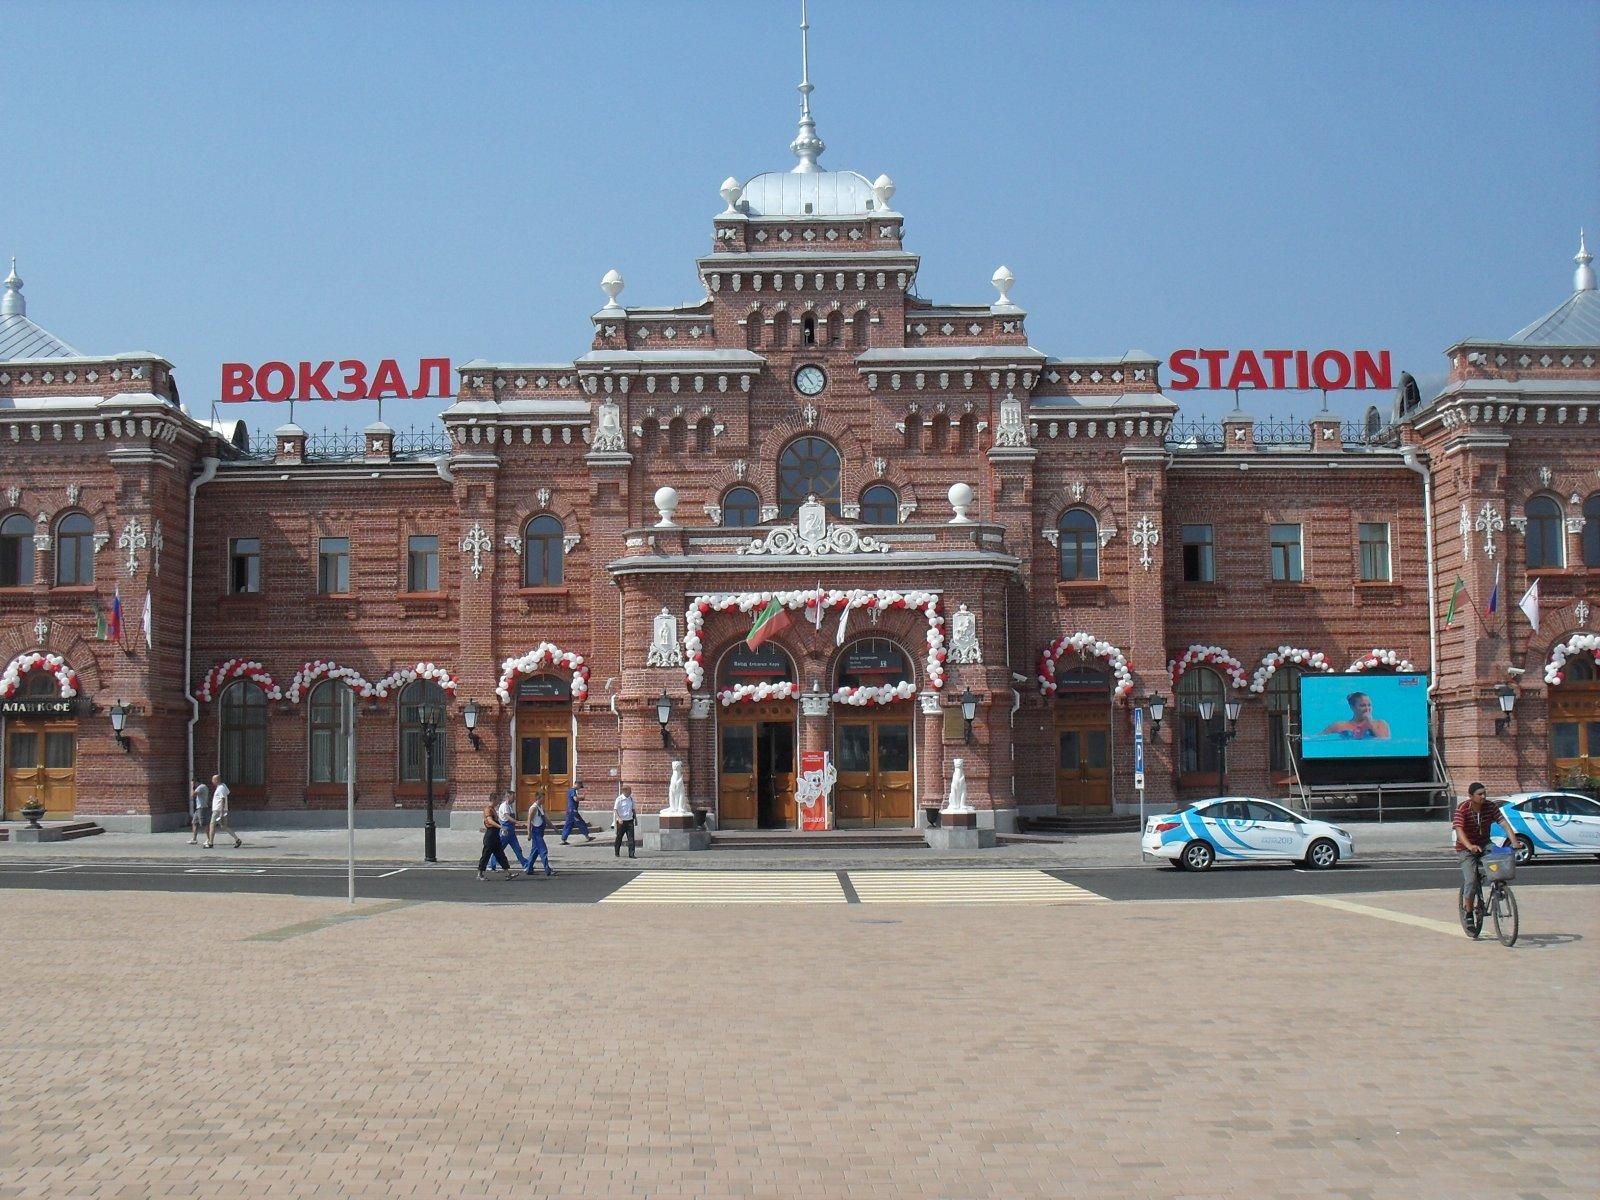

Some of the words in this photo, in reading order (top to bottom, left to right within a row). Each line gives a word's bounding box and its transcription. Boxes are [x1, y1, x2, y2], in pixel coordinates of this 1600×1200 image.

[221, 358, 450, 403] ВОКЗАЛ
[1169, 349, 1392, 391] STATION
[37, 702, 71, 712] КОФЕ
